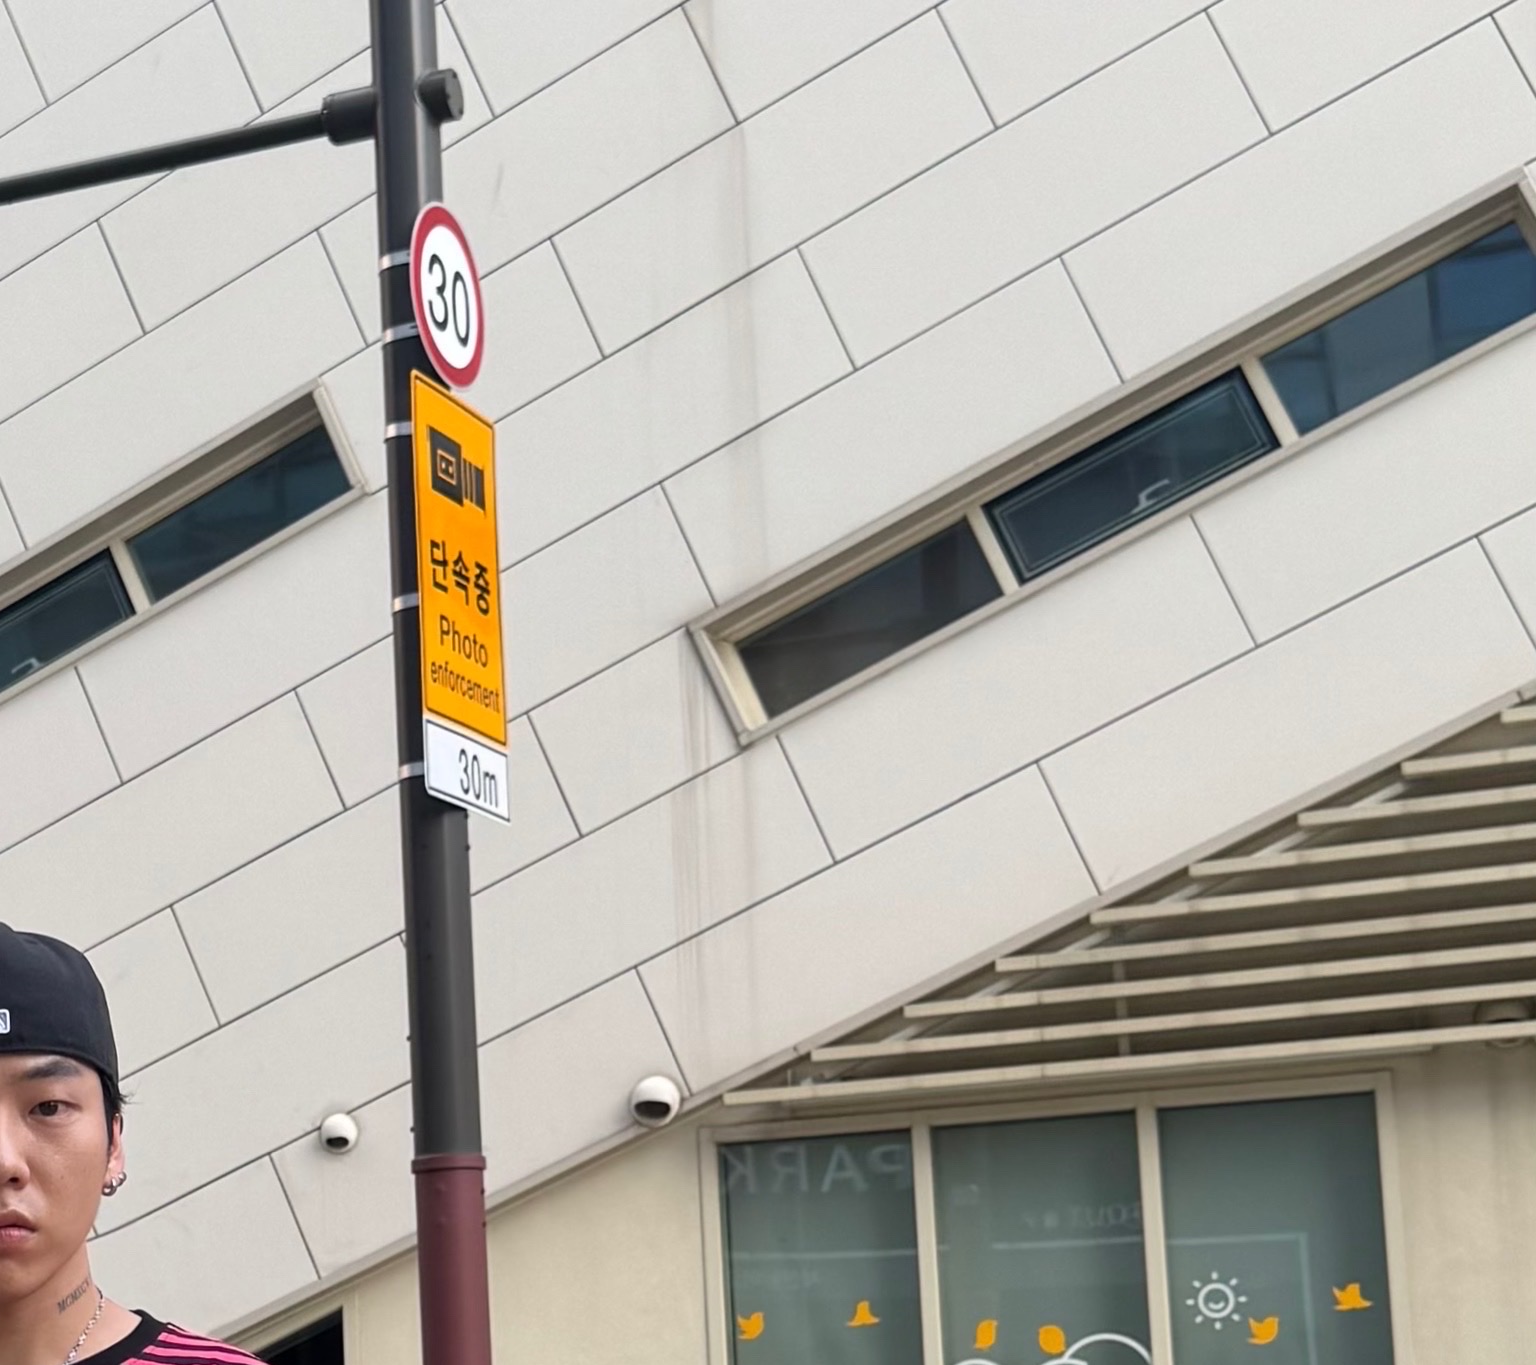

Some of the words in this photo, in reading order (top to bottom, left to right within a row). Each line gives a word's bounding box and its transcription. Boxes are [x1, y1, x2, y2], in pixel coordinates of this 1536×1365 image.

[427, 254, 471, 348] 30
[430, 539, 492, 617] 단속중
[439, 614, 490, 669] Photo
[430, 658, 501, 714] enforcement
[457, 746, 500, 808] 30m
